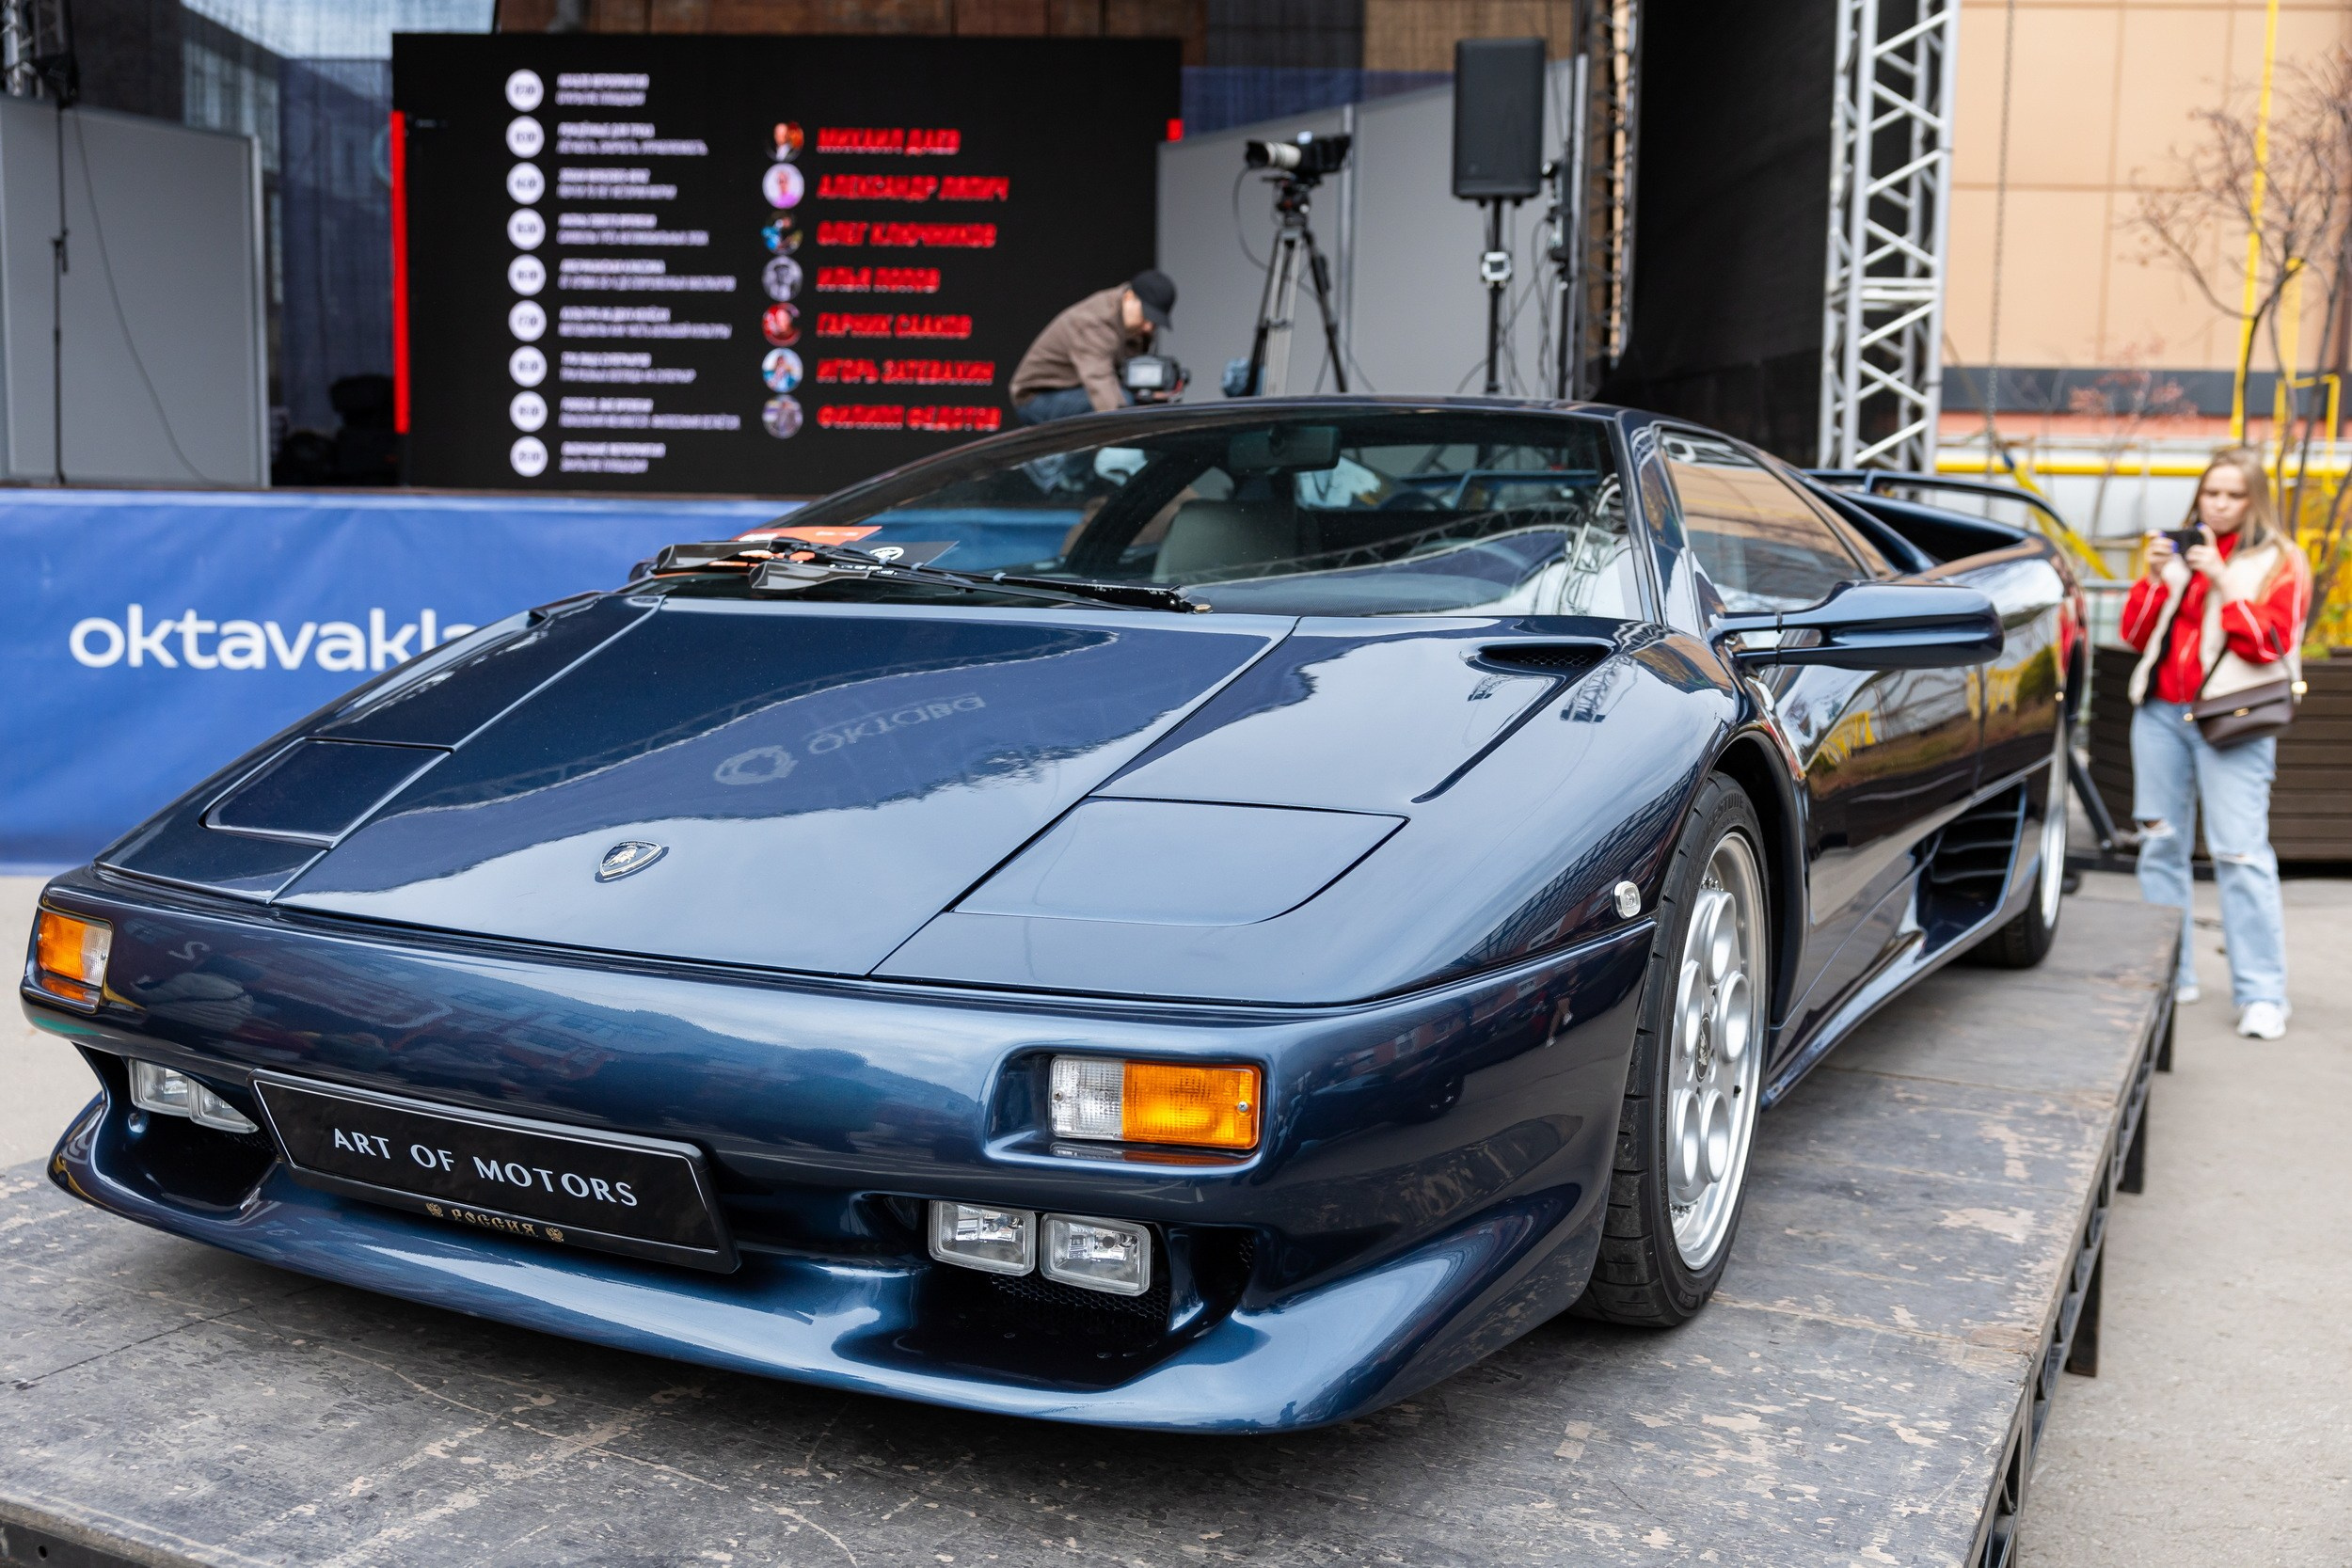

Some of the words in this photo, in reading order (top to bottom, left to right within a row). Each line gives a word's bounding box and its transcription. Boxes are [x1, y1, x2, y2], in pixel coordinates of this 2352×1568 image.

[334, 1128, 391, 1160] ART
[410, 1143, 455, 1172] OF
[472, 1155, 638, 1208] MOTORS
[451, 1208, 539, 1237] РОССИЯ
